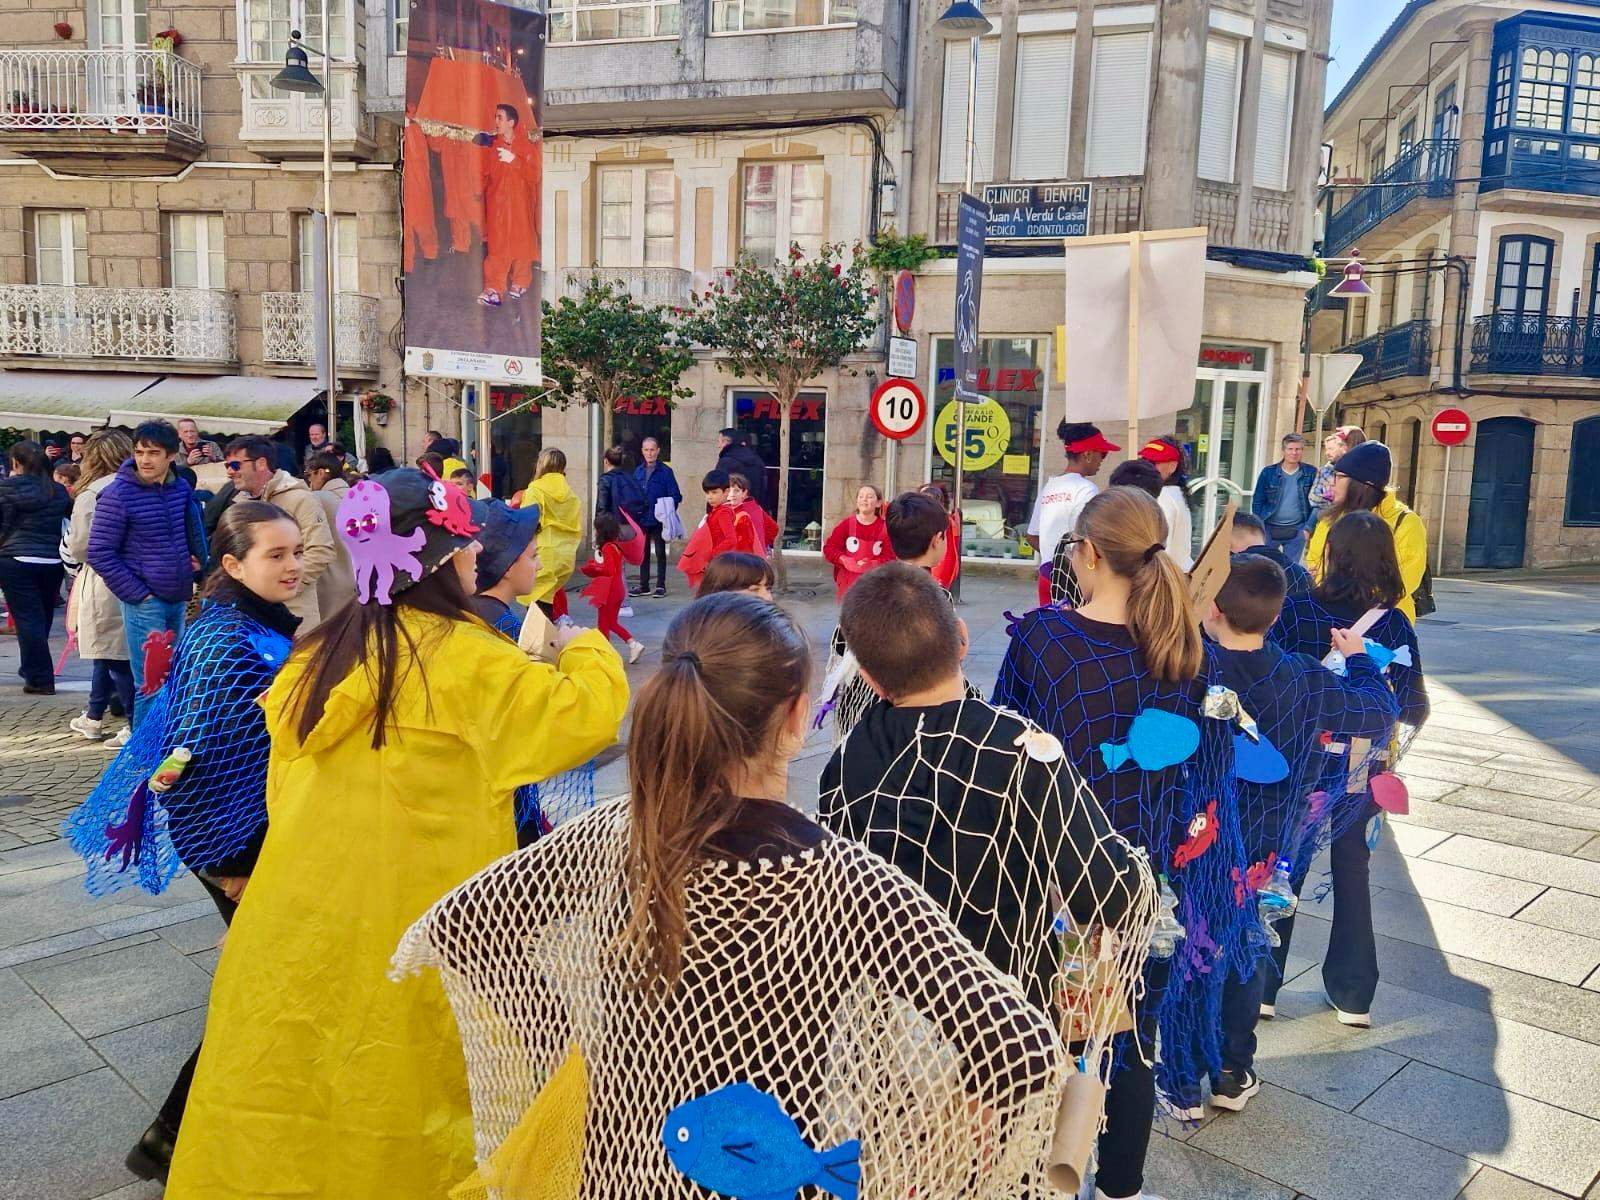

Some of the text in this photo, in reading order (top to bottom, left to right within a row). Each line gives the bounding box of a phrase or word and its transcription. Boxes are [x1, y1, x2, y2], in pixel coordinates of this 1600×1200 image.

[986, 186, 1088, 204] CLINICA DENTAL
[986, 208, 1010, 222] Juan
[1013, 207, 1024, 222] A.
[1025, 207, 1054, 221] Verdú
[1057, 206, 1086, 220] Casal
[985, 225, 1016, 236] MEDICO
[1027, 223, 1085, 235] ODONTOLOGO
[976, 367, 1041, 391] LEX
[886, 396, 914, 420] 10
[953, 414, 993, 424] GANDE
